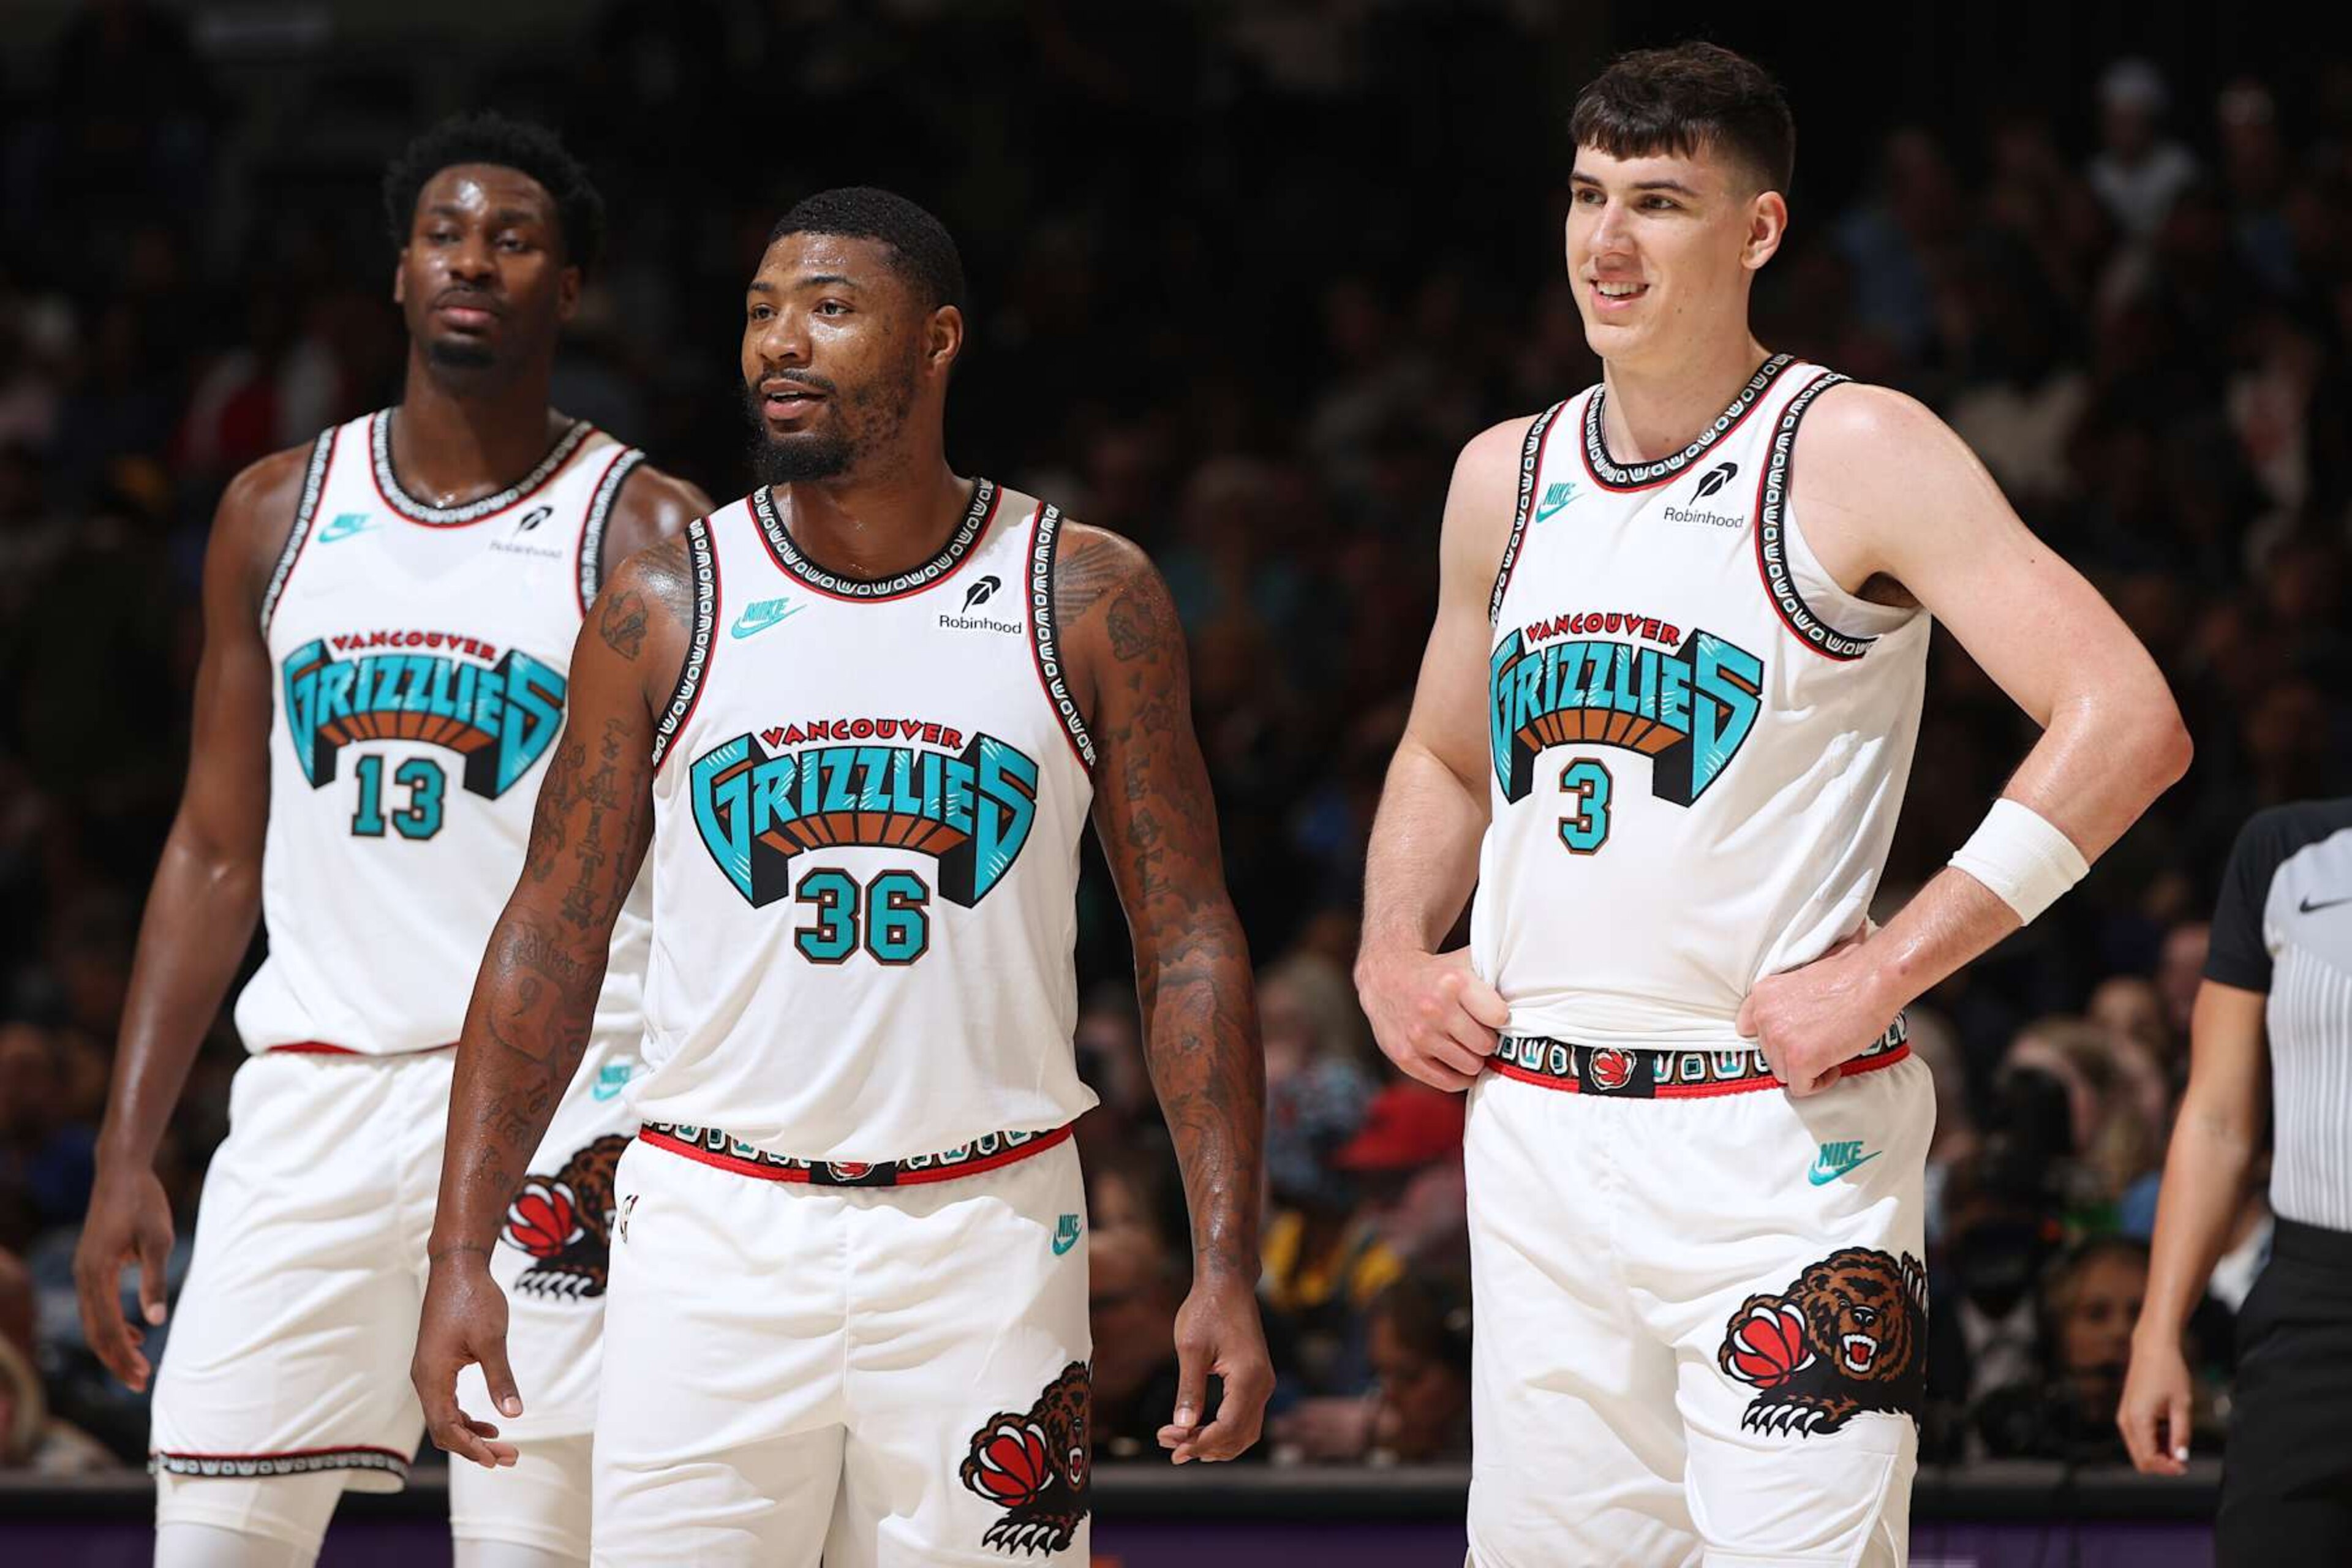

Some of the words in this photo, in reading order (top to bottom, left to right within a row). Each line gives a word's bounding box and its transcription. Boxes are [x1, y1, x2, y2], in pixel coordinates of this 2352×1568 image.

[1543, 482, 1576, 506] NIKE
[1664, 507, 1744, 528] Robinhood
[742, 597, 790, 622] NIKE
[939, 614, 1022, 634] Robinhood
[332, 630, 497, 662] VANCOUVER
[1526, 613, 1680, 647] VANCOUVER
[282, 638, 567, 801] GRIZZLIES
[1490, 627, 1764, 808] GRIZZLIES
[761, 718, 965, 750] VANCOUVER
[352, 754, 446, 841] 13
[1559, 757, 1613, 856] 3
[689, 731, 1040, 909] GRIZZLIES
[794, 867, 930, 966] 36
[1818, 1140, 1864, 1168] NIKE
[1058, 1214, 1079, 1237] NIKE
